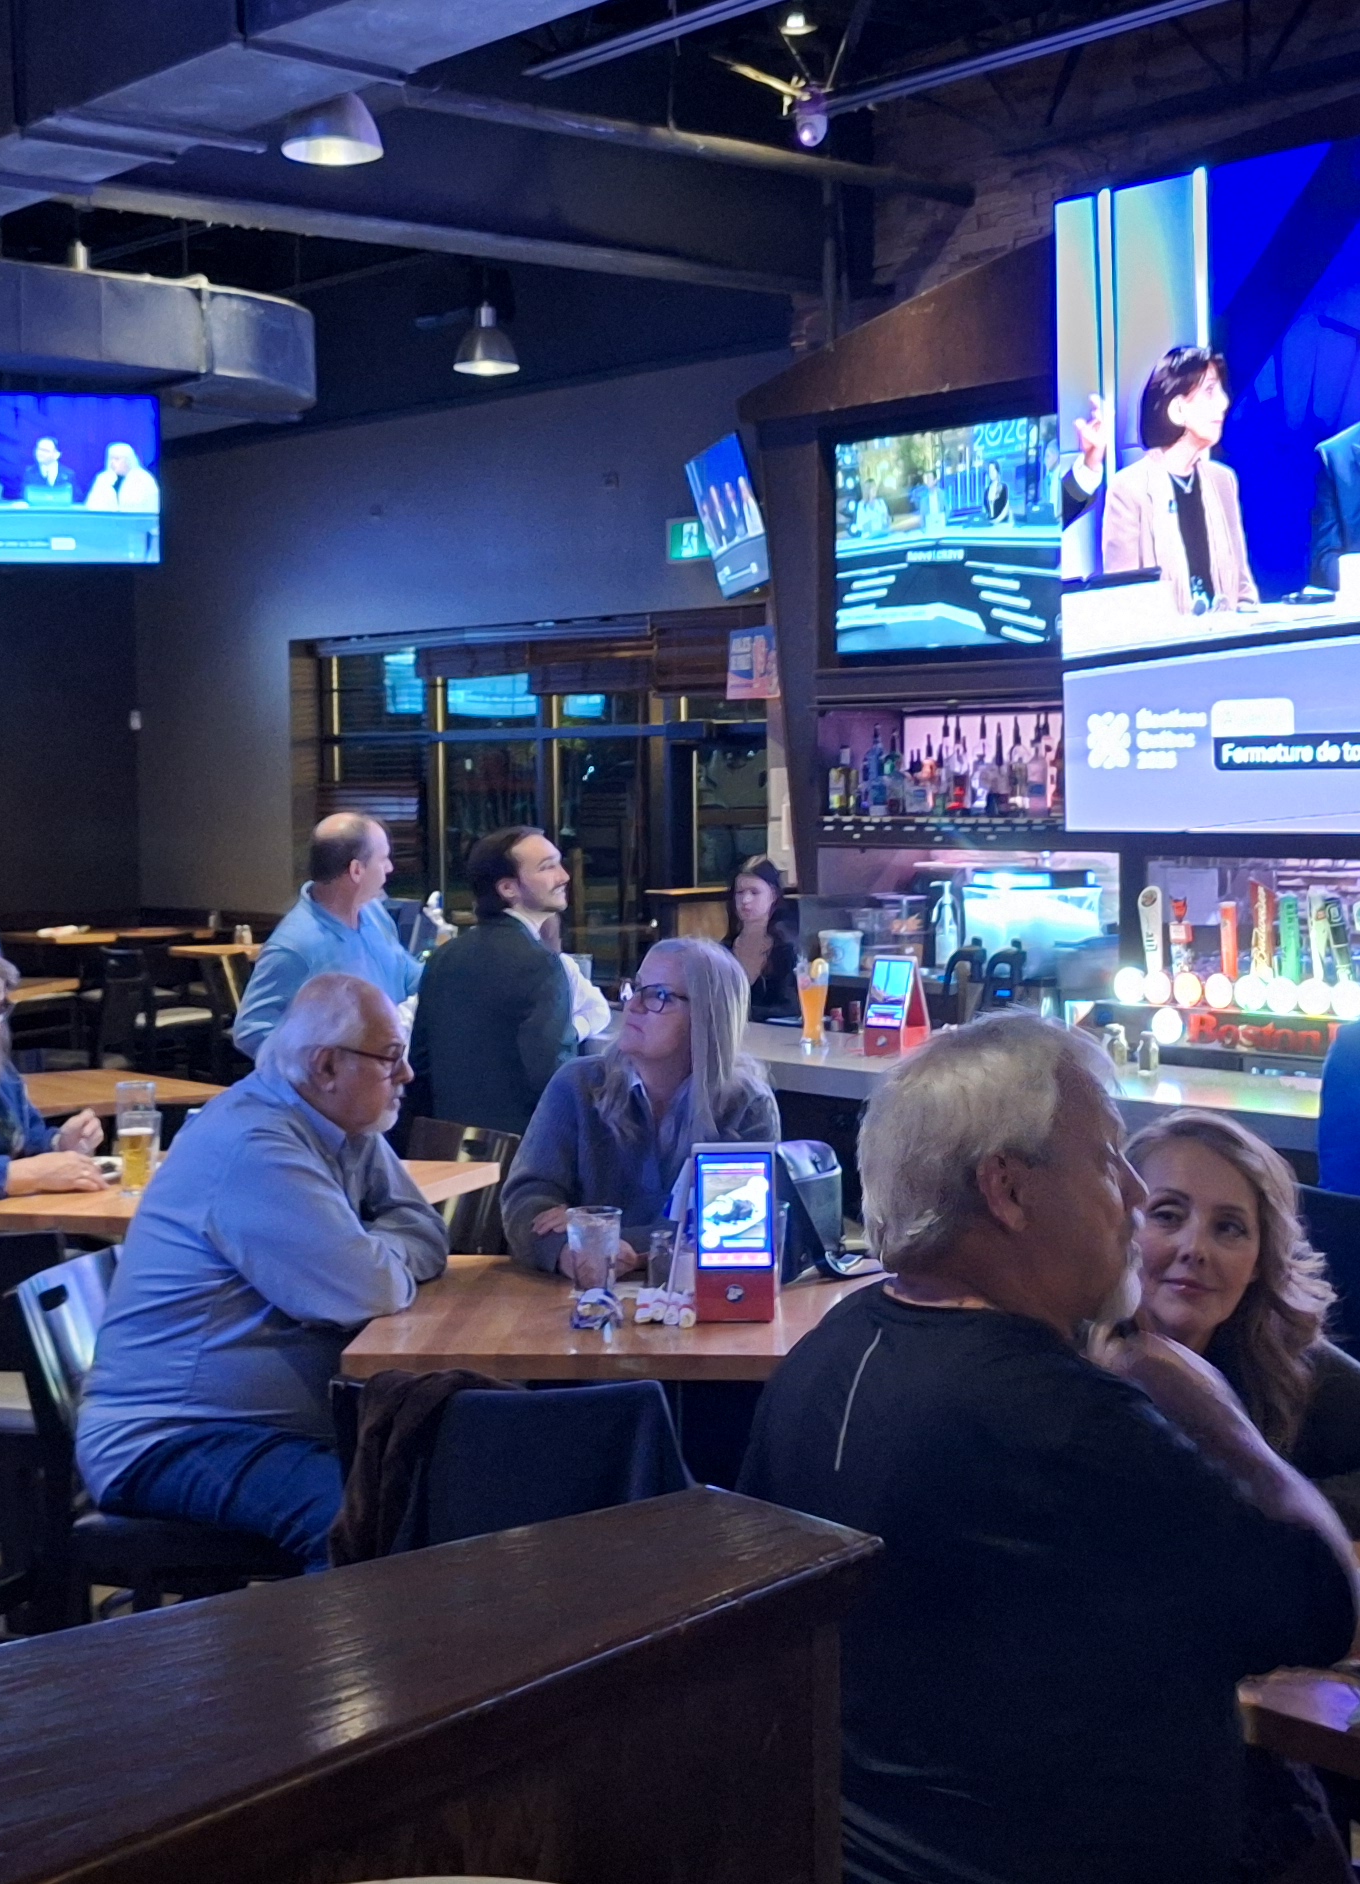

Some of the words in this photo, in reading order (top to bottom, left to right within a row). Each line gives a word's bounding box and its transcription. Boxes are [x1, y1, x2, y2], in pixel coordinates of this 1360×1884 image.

[1221, 741, 1313, 763] Fermeture
[1316, 740, 1340, 762] de
[1186, 1013, 1322, 1054] Boston
